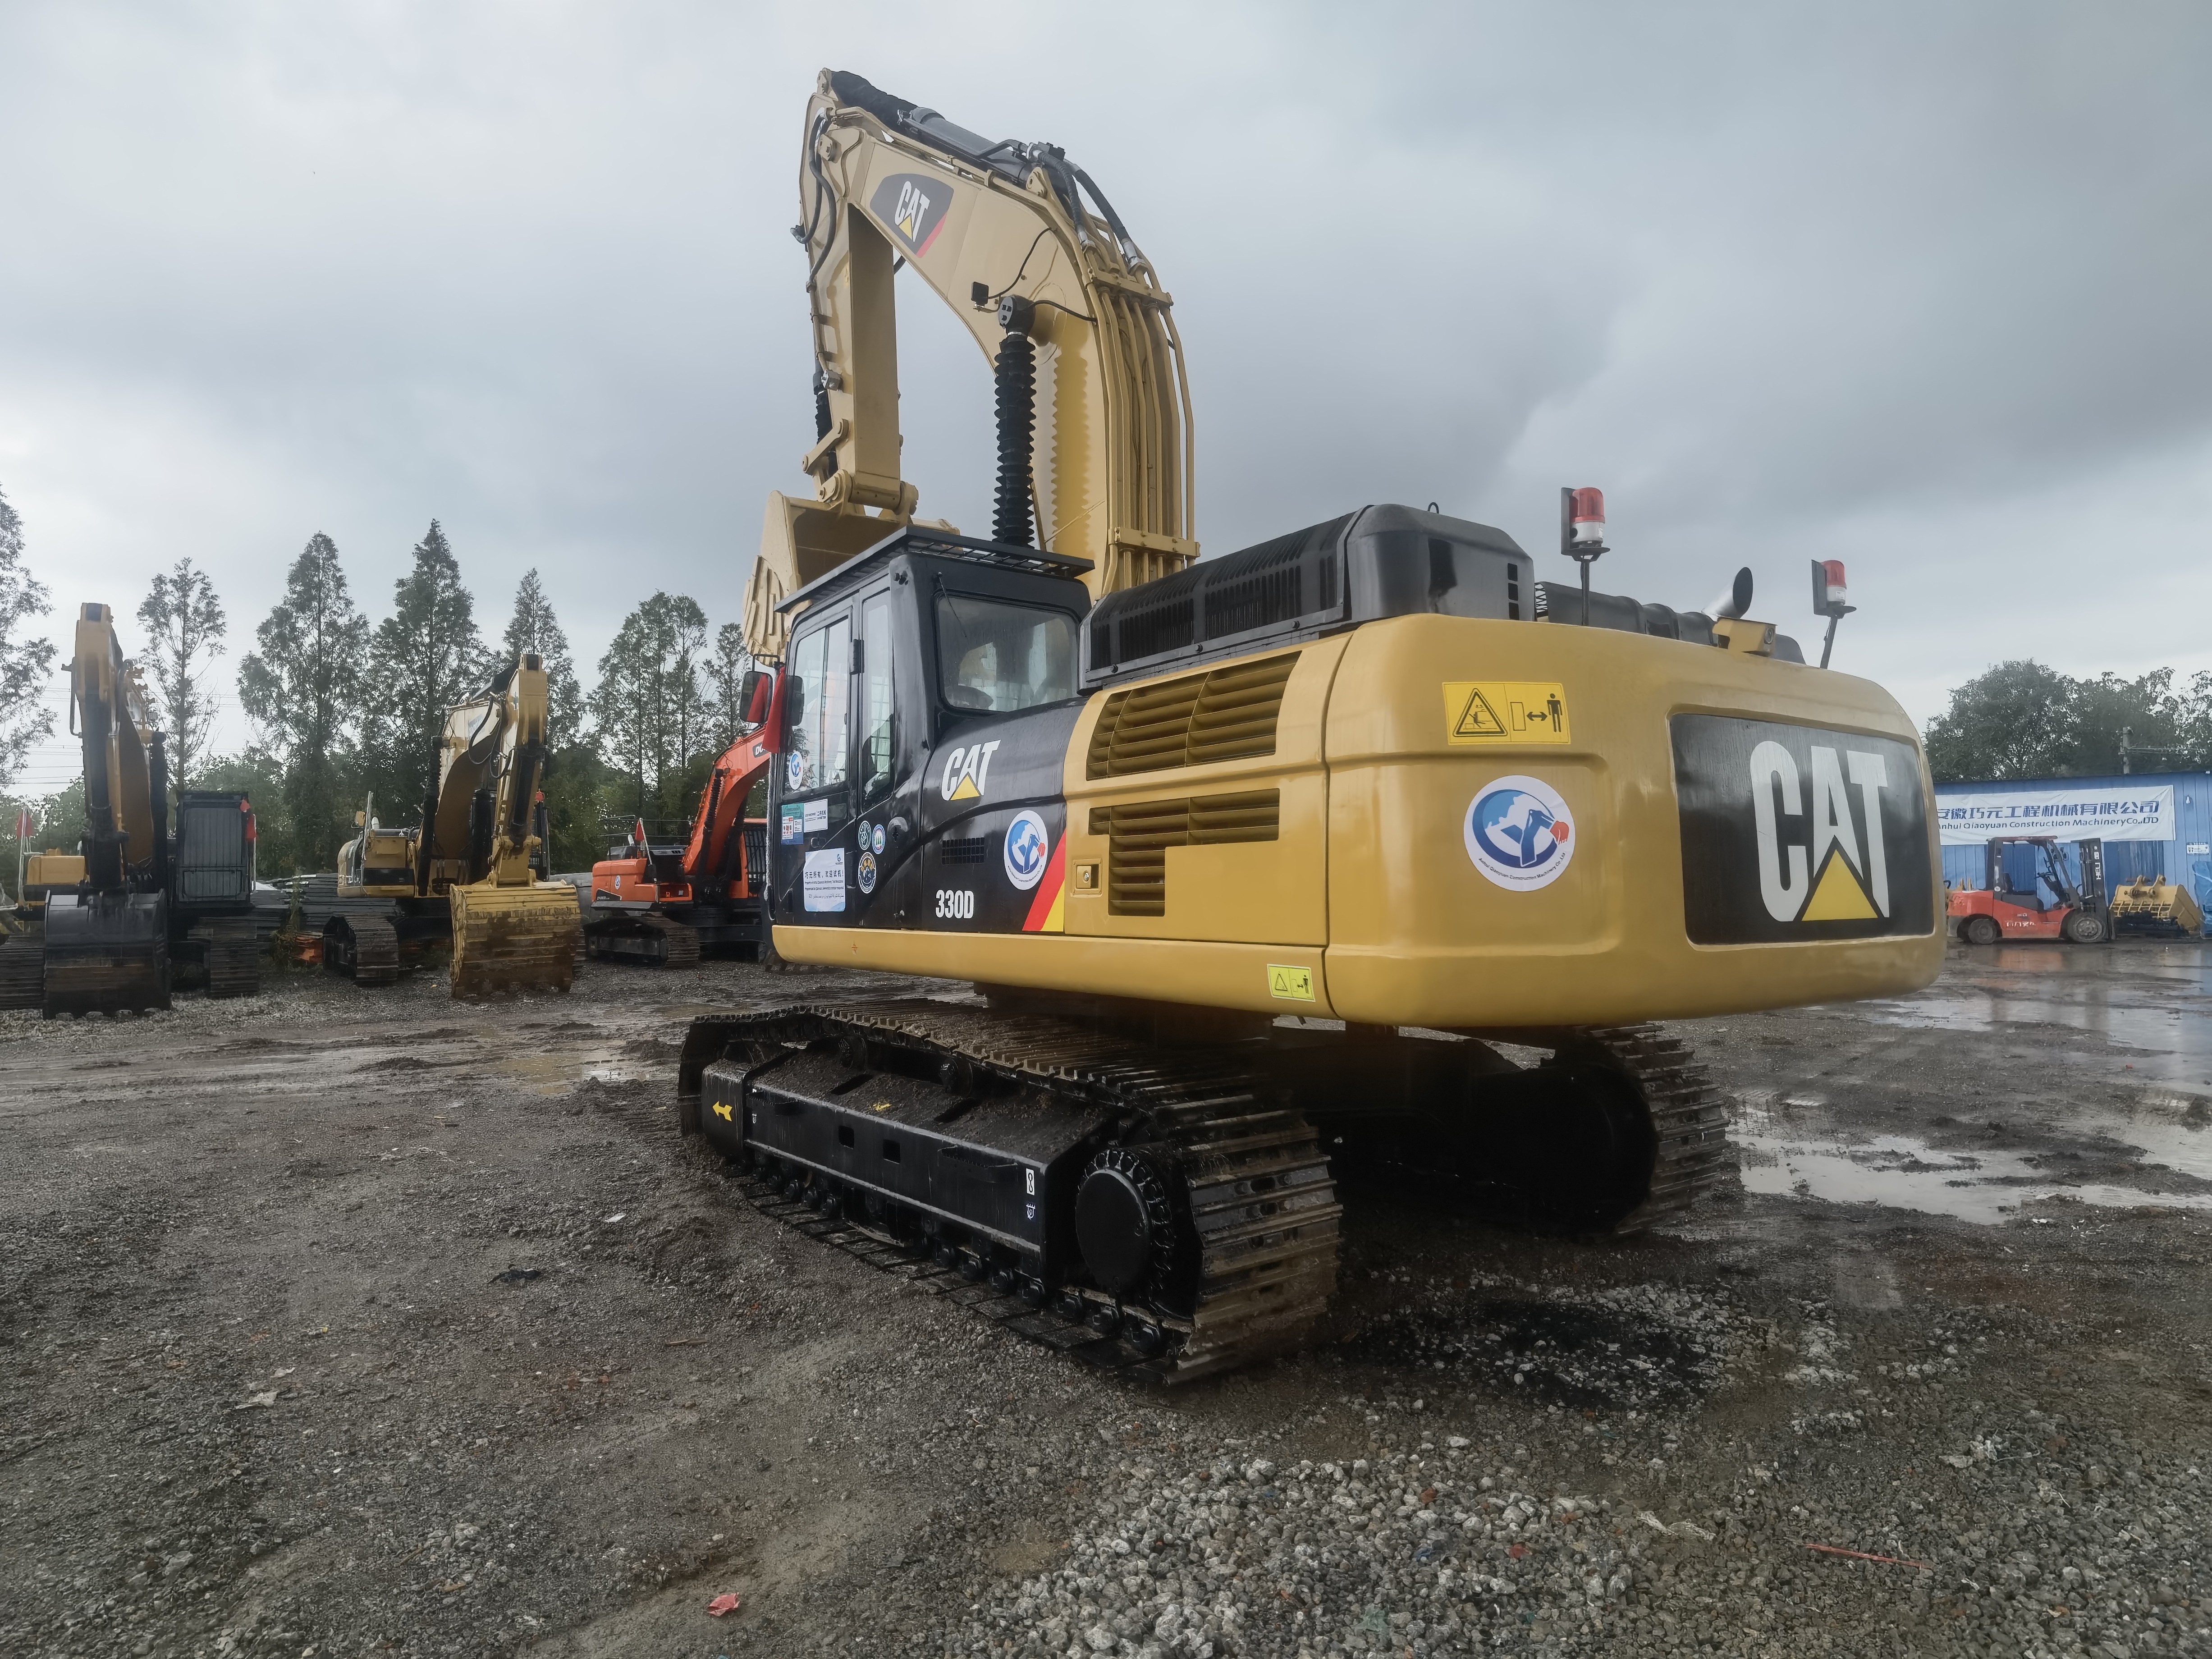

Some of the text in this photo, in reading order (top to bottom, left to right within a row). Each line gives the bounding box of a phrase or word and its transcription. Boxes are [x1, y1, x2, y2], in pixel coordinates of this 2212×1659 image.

[894, 181, 930, 242] CAT
[942, 740, 1001, 801] CAT
[1750, 741, 1890, 922] CAT
[1964, 822, 2007, 830] Qiaoyuan
[2010, 819, 2070, 828] Construction
[2072, 818, 2125, 826] Machinery
[935, 889, 974, 919] 330D
